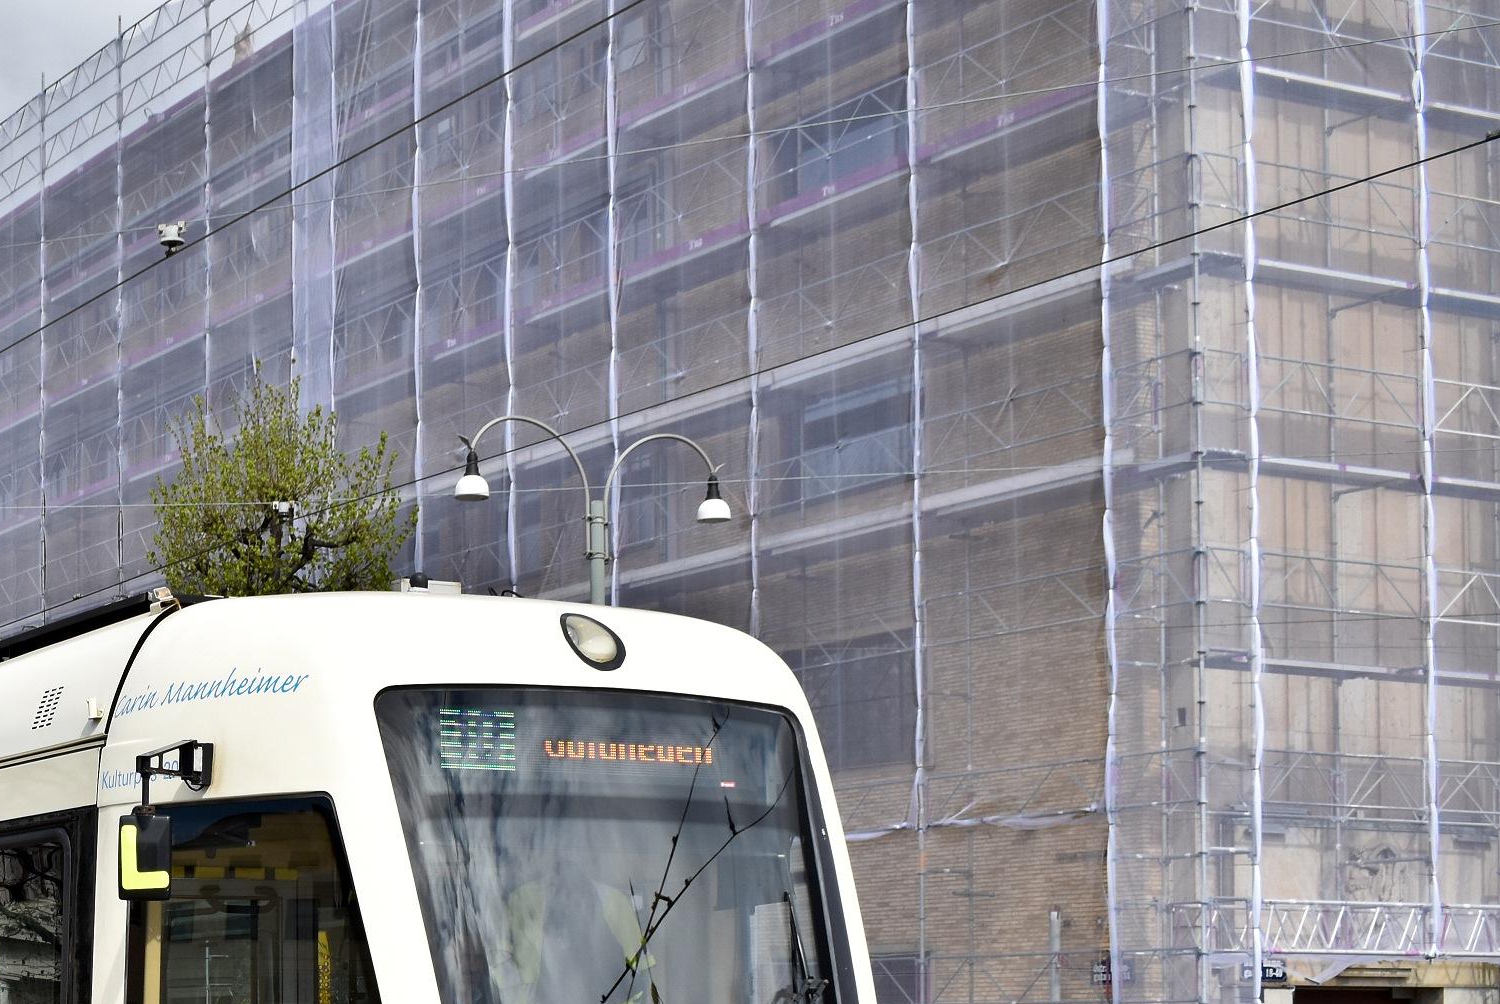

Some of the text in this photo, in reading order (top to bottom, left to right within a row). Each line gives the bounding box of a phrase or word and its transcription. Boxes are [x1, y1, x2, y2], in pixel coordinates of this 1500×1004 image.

[115, 667, 309, 718] Carin Mannheimer
[102, 769, 157, 790] Kulturps
